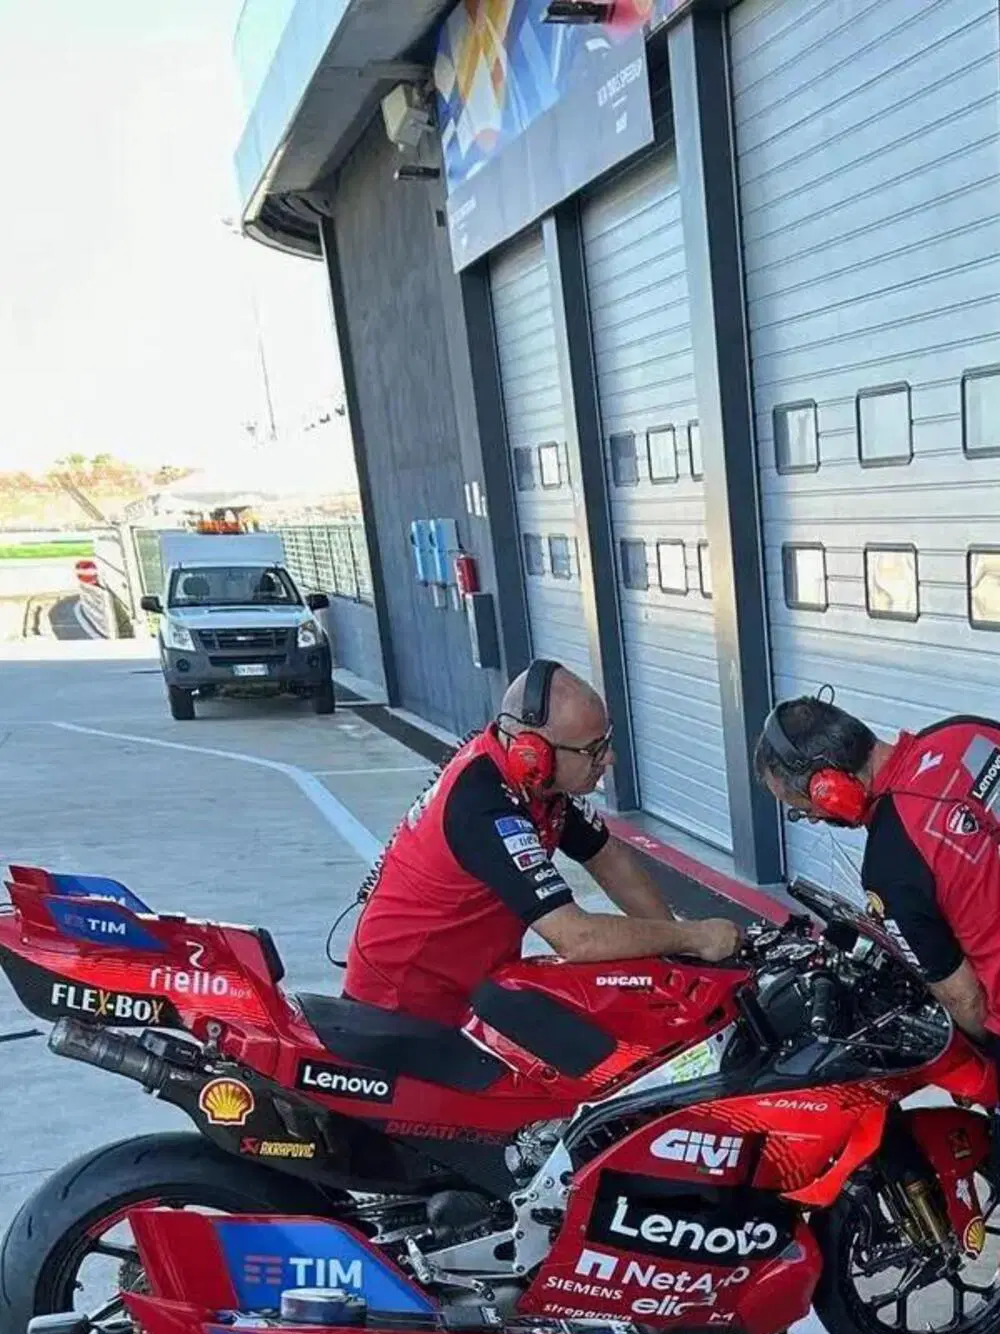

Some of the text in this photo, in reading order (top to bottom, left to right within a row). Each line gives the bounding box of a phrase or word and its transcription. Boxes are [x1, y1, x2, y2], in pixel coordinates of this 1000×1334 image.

[88, 918, 127, 936] TIM
[150, 966, 229, 996] riello
[596, 975, 652, 987] DUCATI
[51, 982, 164, 1025] FLEX-BOX
[303, 1065, 389, 1097] Lenovo
[774, 1099, 829, 1113] DAIKO
[650, 1128, 744, 1168] GIVI
[610, 1196, 777, 1255] Lenovo
[289, 1257, 363, 1289] TIM
[546, 1275, 624, 1300] SIEMENS
